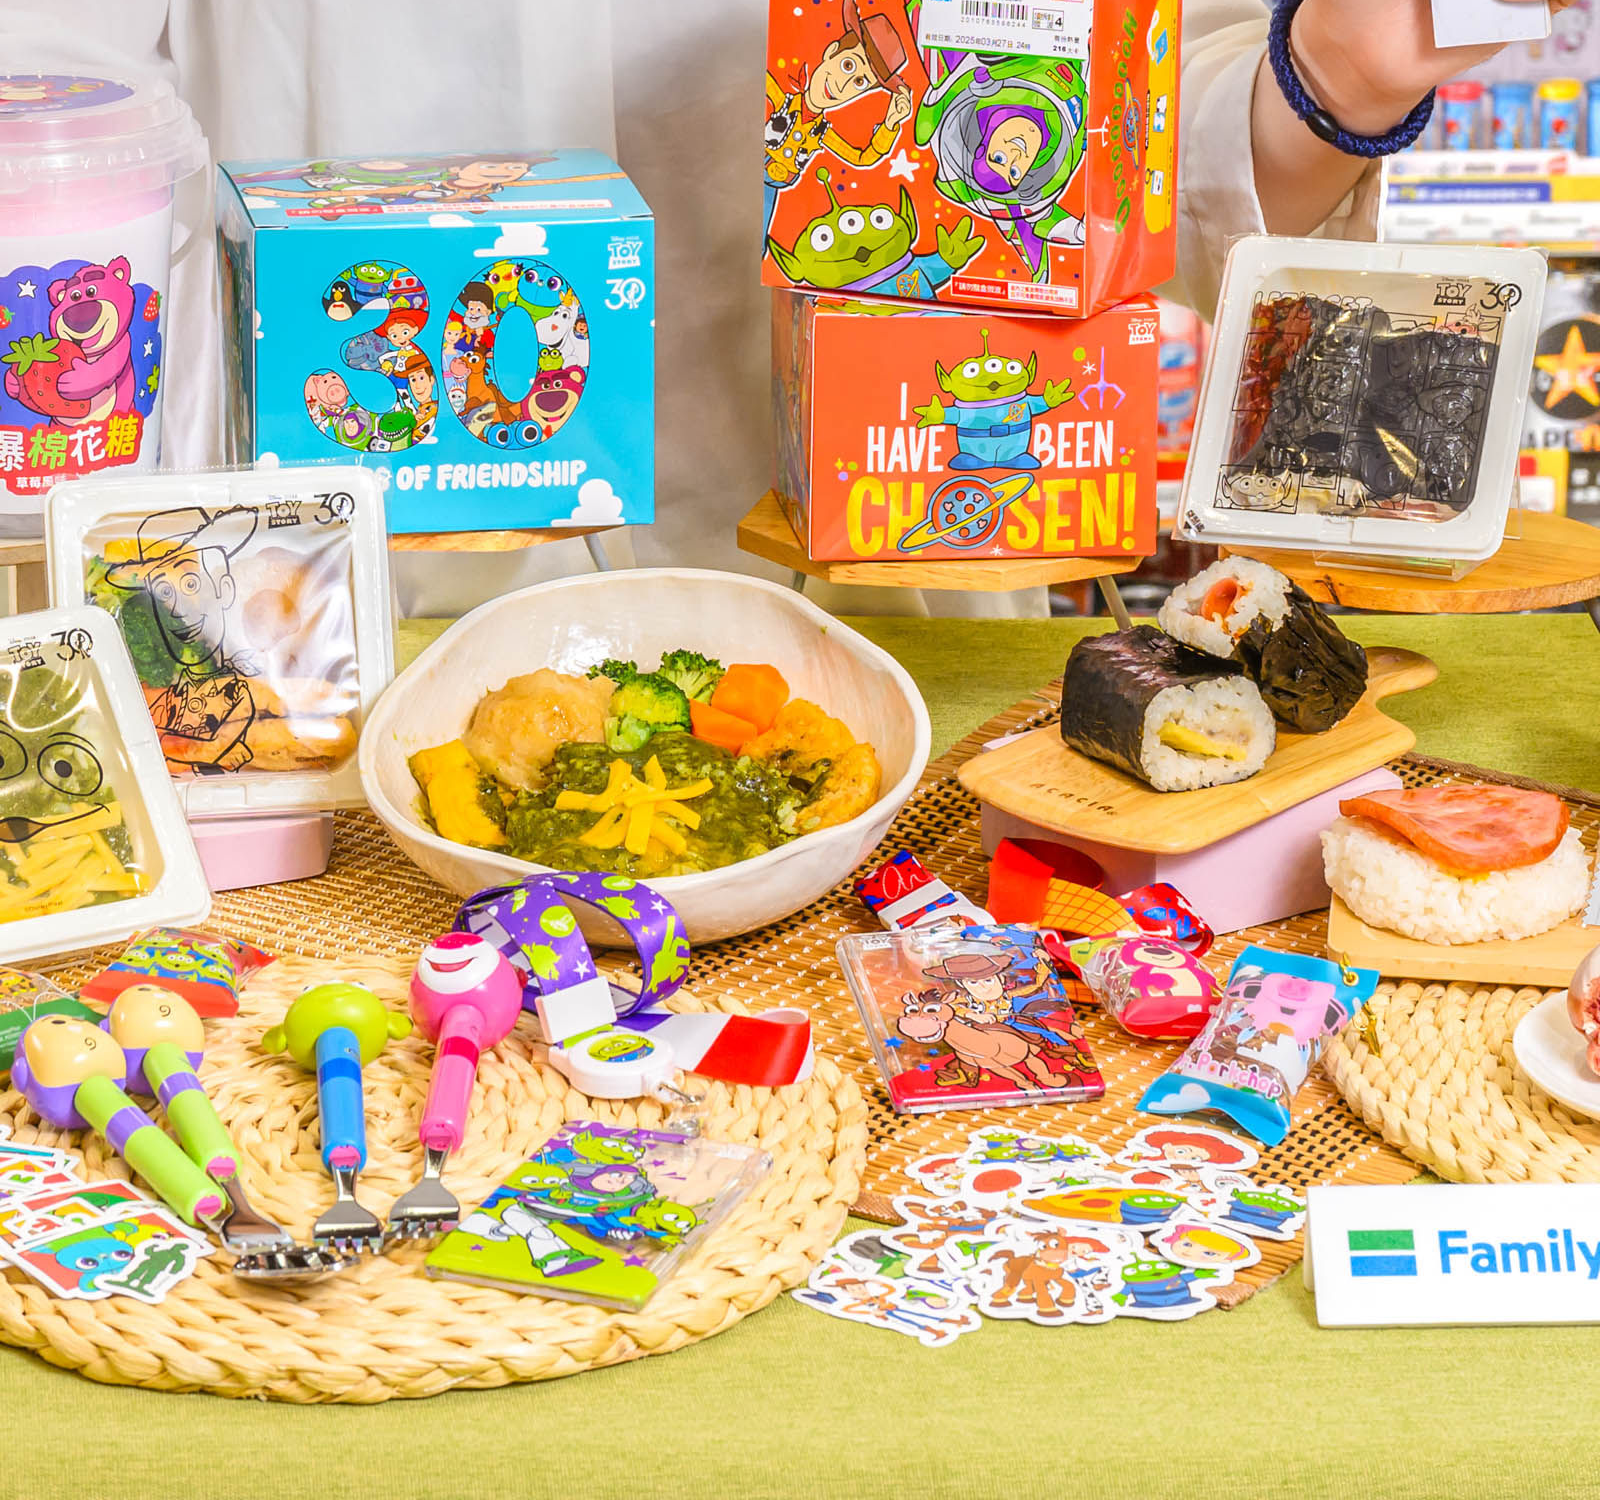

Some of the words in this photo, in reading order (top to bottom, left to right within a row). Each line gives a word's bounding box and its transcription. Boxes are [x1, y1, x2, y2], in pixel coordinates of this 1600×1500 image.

[608, 241, 643, 258] TOY
[604, 277, 646, 311] 30
[1435, 282, 1472, 299] TOY
[1479, 281, 1522, 312] 30
[1127, 322, 1157, 335] TOY
[304, 257, 591, 453] 30
[900, 383, 908, 421] I
[867, 424, 946, 474] HAVE
[1034, 420, 1115, 469] BEEN
[396, 465, 430, 489] OF
[436, 459, 588, 491] FRIENDSHIP
[266, 501, 302, 518] TOY
[313, 492, 355, 524] 30
[8, 643, 42, 661] TOY
